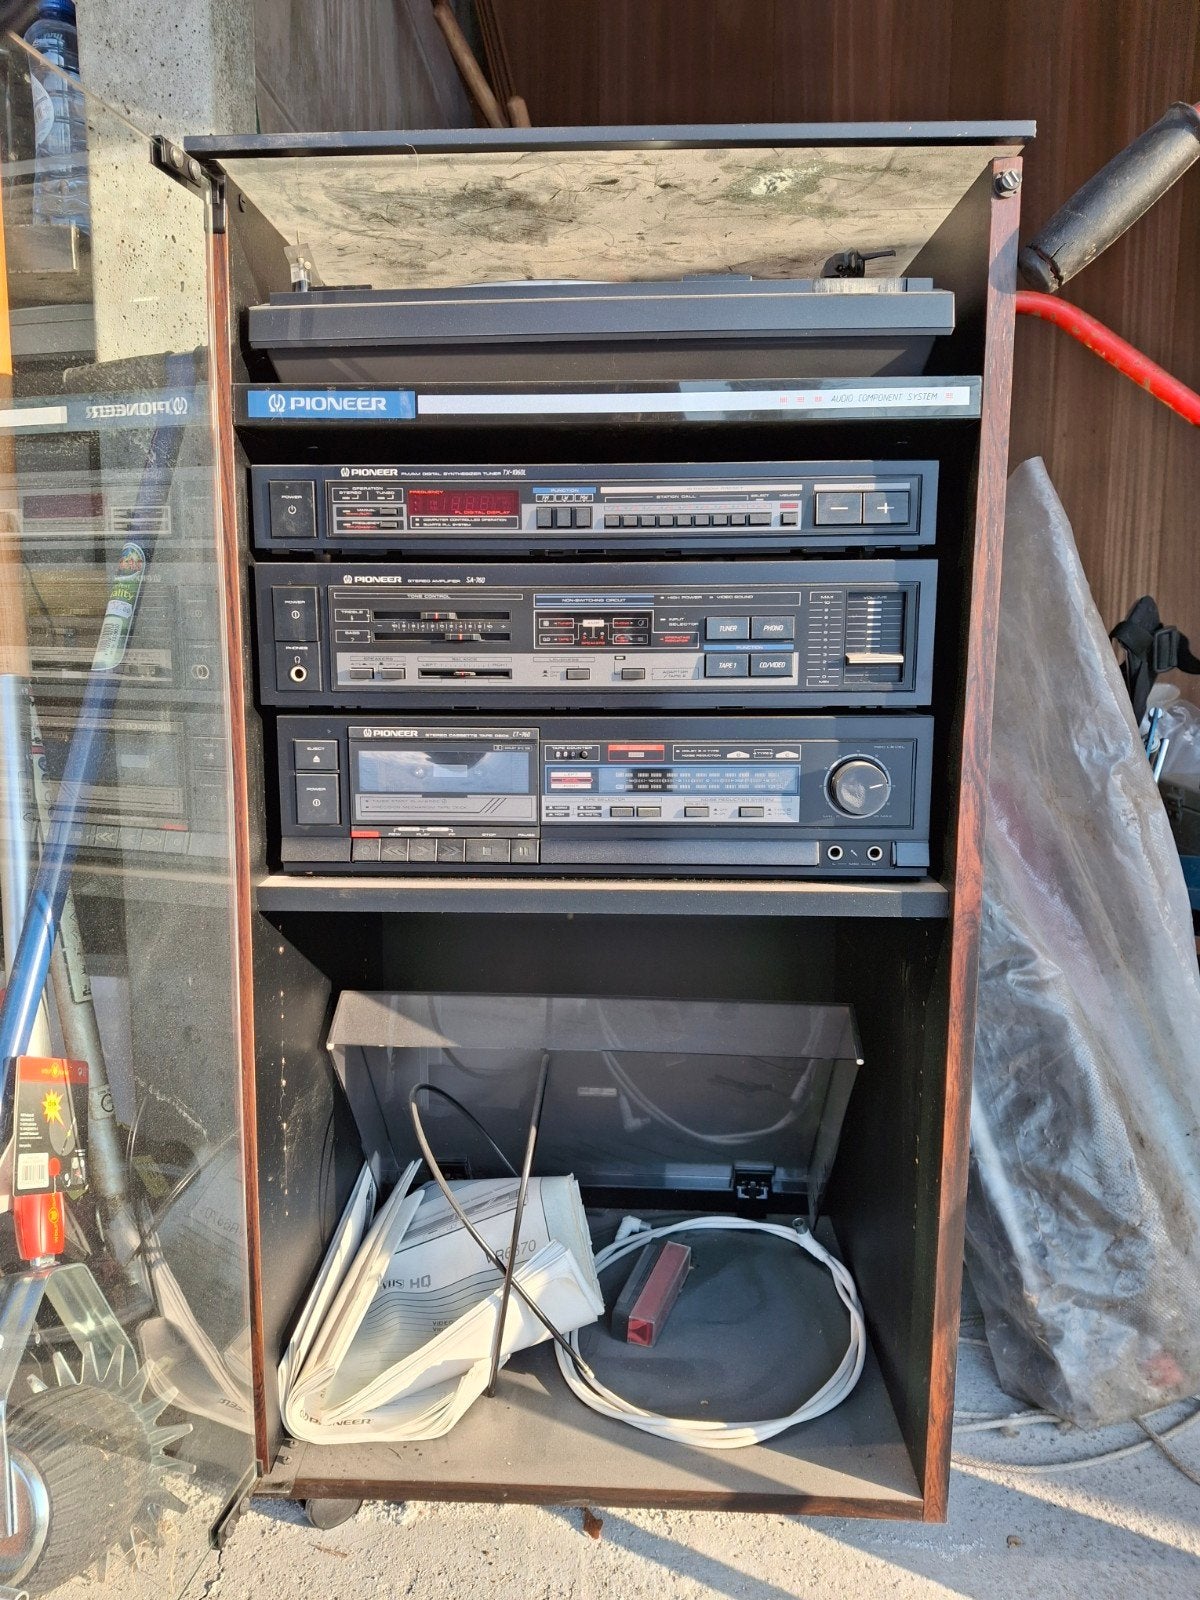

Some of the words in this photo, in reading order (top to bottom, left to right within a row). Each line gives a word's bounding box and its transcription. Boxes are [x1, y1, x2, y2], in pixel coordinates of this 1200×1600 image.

[831, 394, 855, 403] AUDIO
[858, 393, 904, 402] COMPONENT
[907, 392, 938, 401] SYSTEM
[290, 396, 387, 412] PIONEER
[351, 468, 398, 477] PIONEER
[354, 576, 402, 584] PIONEER
[372, 729, 419, 738] PIONEER
[382, 1279, 403, 1290] VHS
[409, 1274, 432, 1289] HQ
[309, 1416, 375, 1427] PNEER
